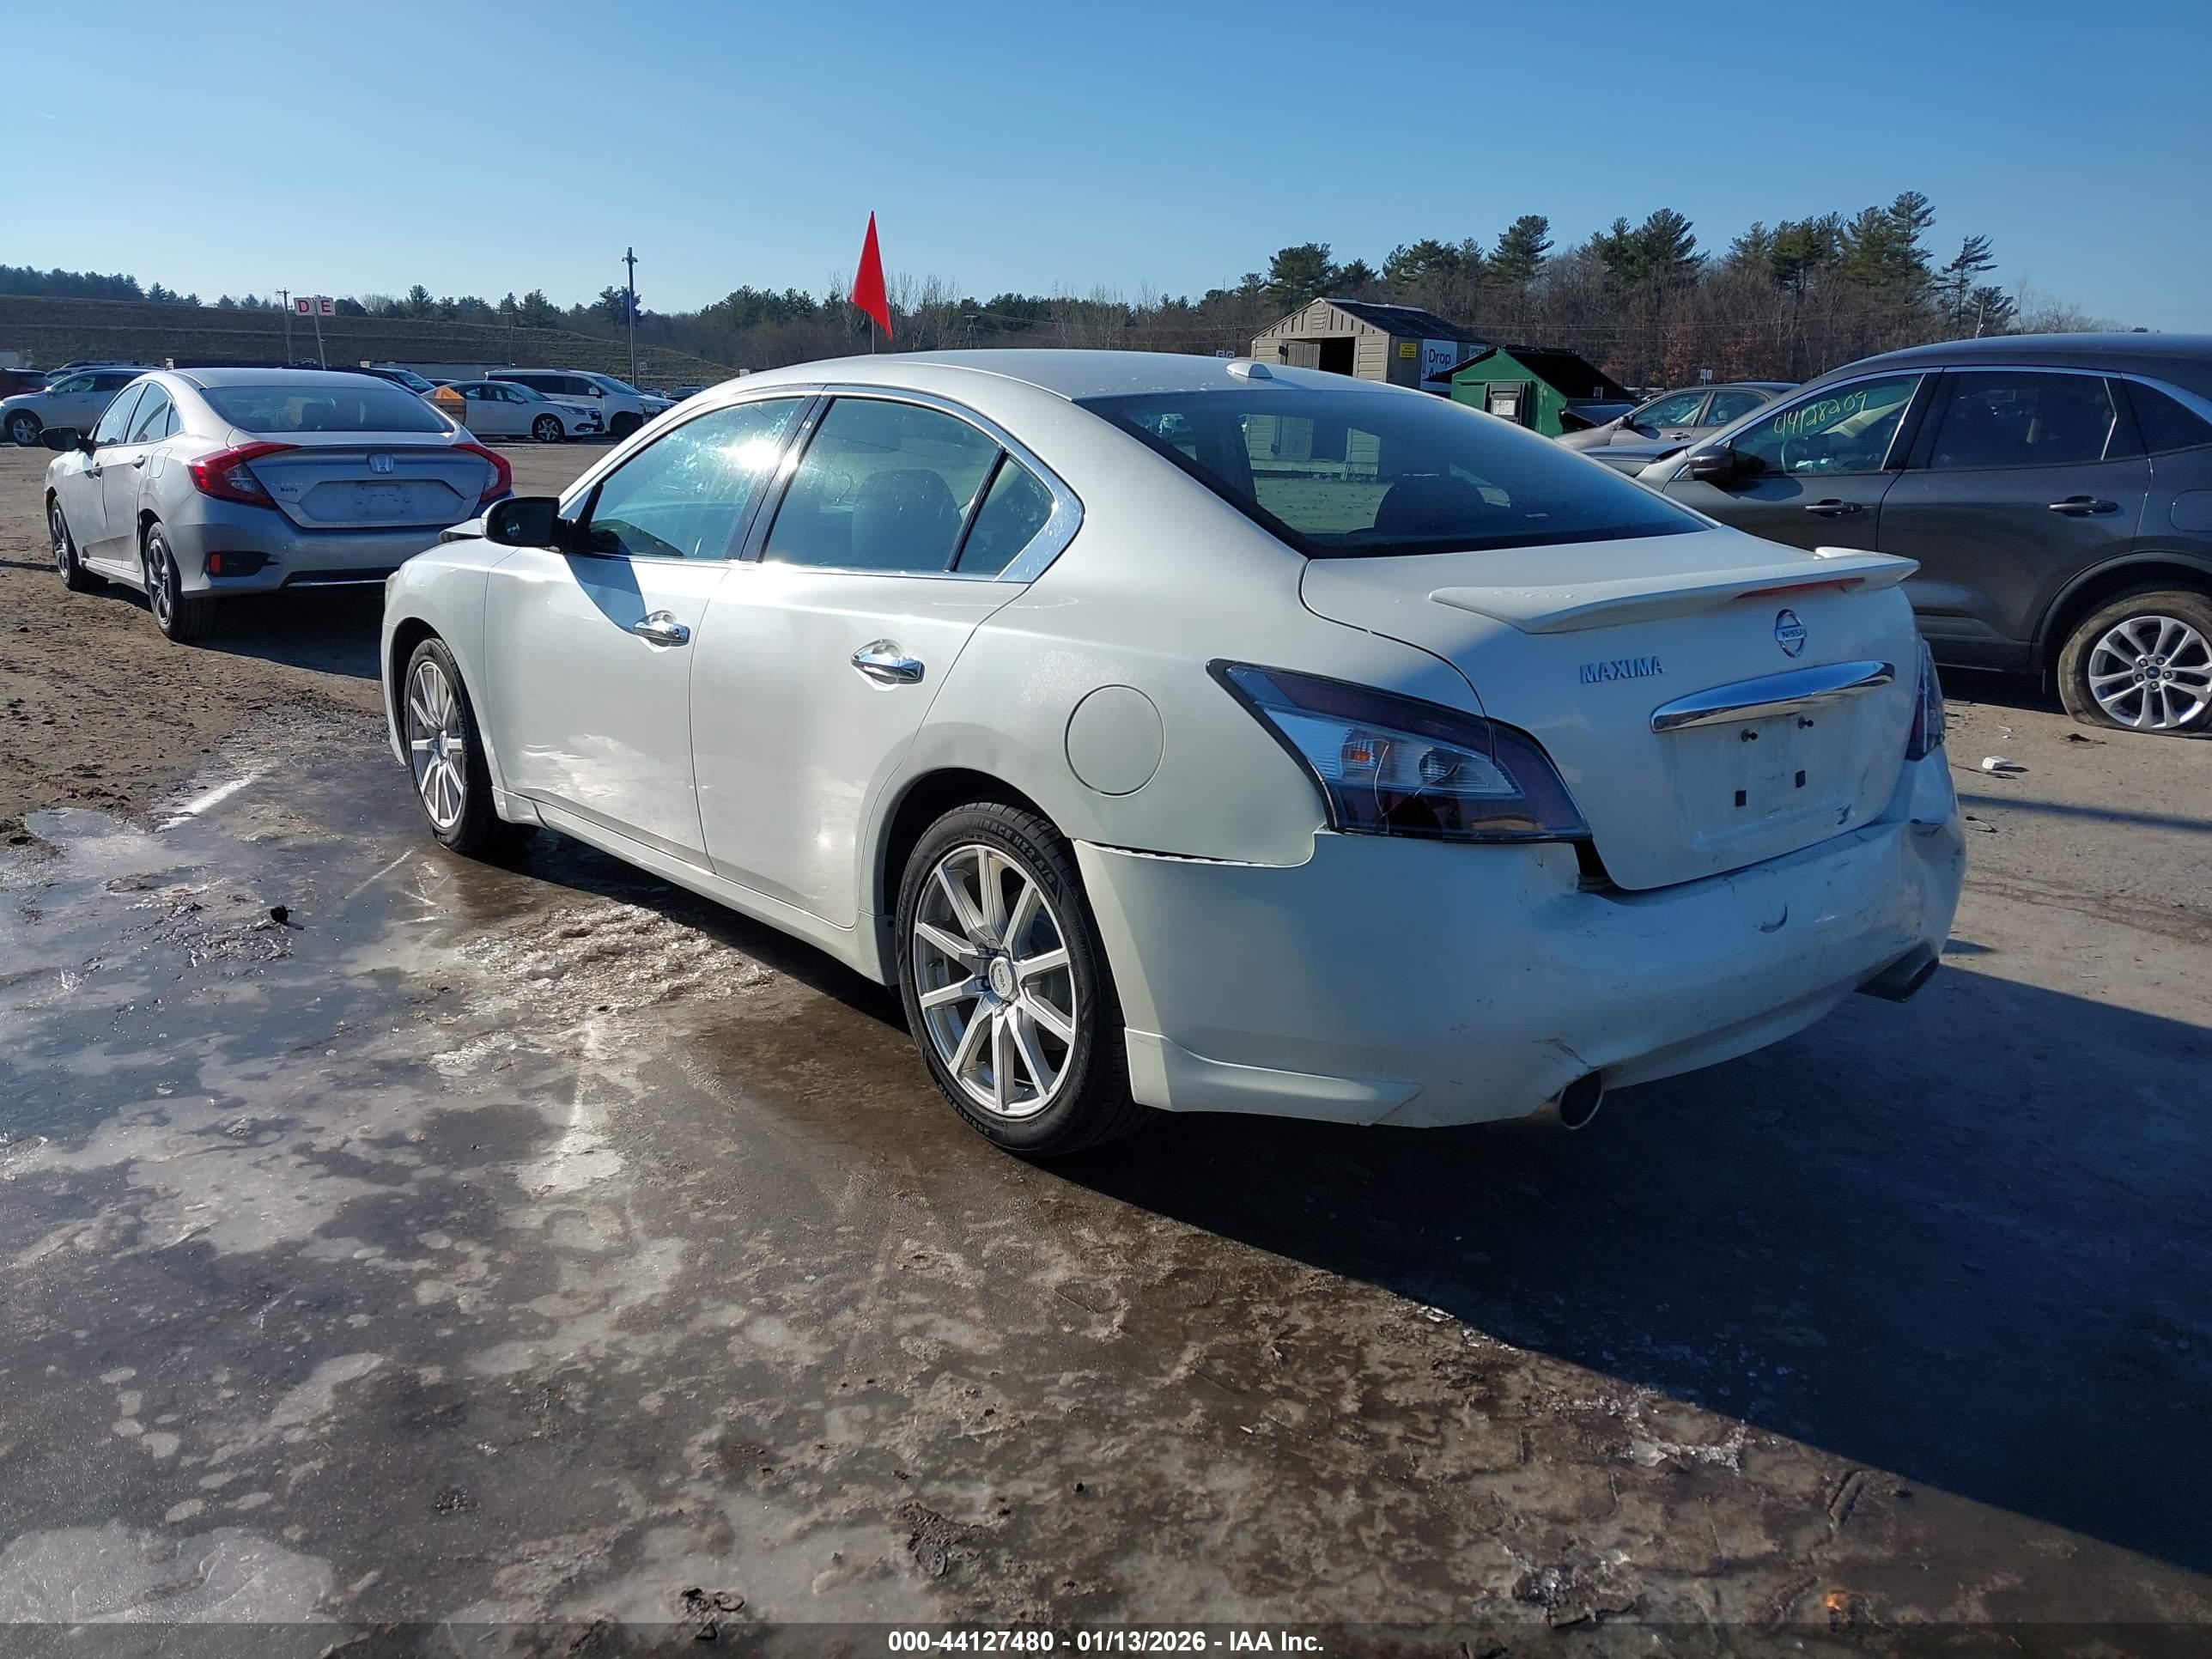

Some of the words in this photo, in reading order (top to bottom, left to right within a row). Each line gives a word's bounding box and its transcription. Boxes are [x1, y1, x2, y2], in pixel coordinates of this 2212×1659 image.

[297, 300, 310, 313] D
[320, 300, 332, 313] E
[1428, 349, 1451, 367] Drop
[1773, 391, 1868, 438] 44128209
[1579, 655, 1664, 684] MAXIMA
